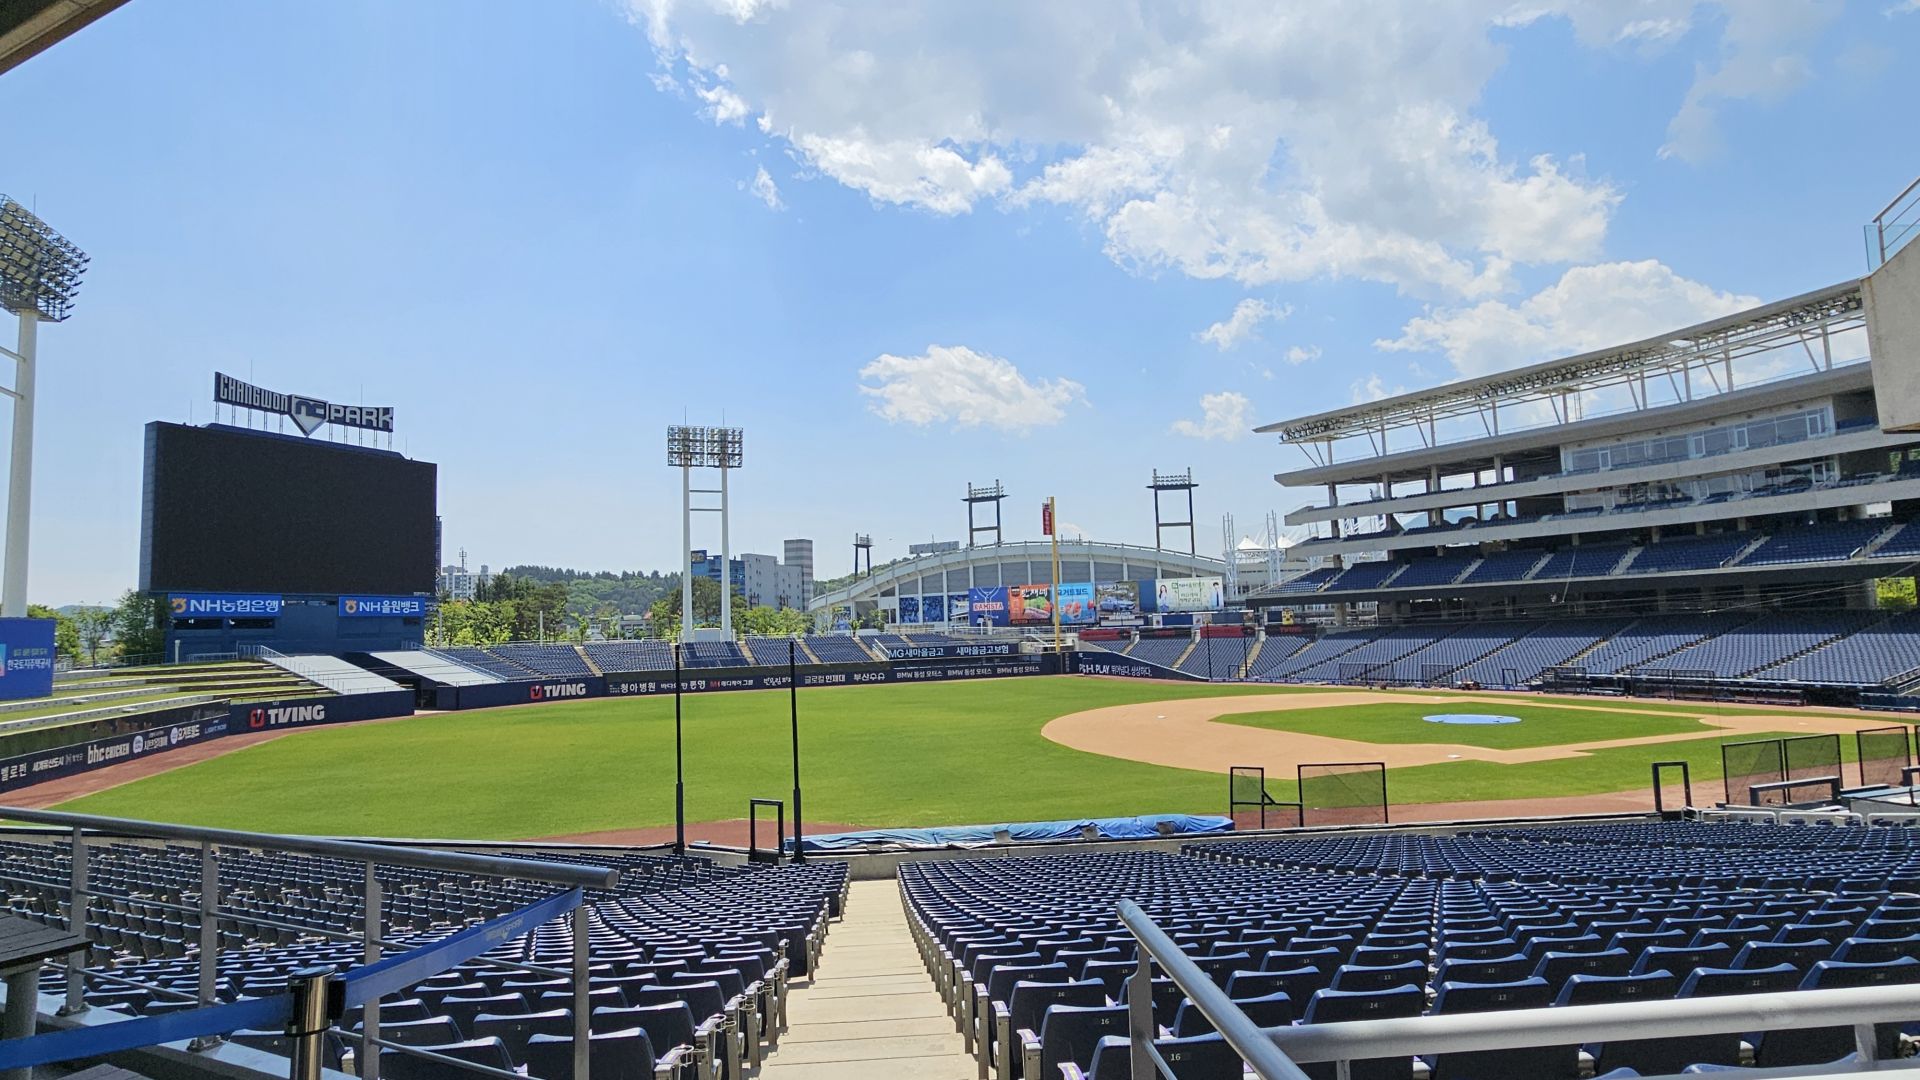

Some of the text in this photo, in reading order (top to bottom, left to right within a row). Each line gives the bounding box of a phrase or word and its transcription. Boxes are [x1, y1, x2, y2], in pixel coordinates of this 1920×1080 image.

[219, 373, 289, 412] CHANGWON
[330, 405, 394, 429] PARK
[190, 598, 280, 613] NH농협은행
[359, 600, 420, 614] NH올원뱅크
[889, 647, 944, 659] MG새마을금고
[956, 645, 1009, 656] 새마을금고보험
[976, 667, 992, 675] 모터스
[1024, 665, 1040, 673] 모터스
[1095, 664, 1110, 674] PLAY
[854, 672, 885, 682] 부산우유
[544, 683, 586, 698] TVING
[620, 682, 656, 694] 청아병원
[267, 704, 325, 725] TVING
[87, 744, 105, 764] bhc
[1170, 1053, 1181, 1061] 16
